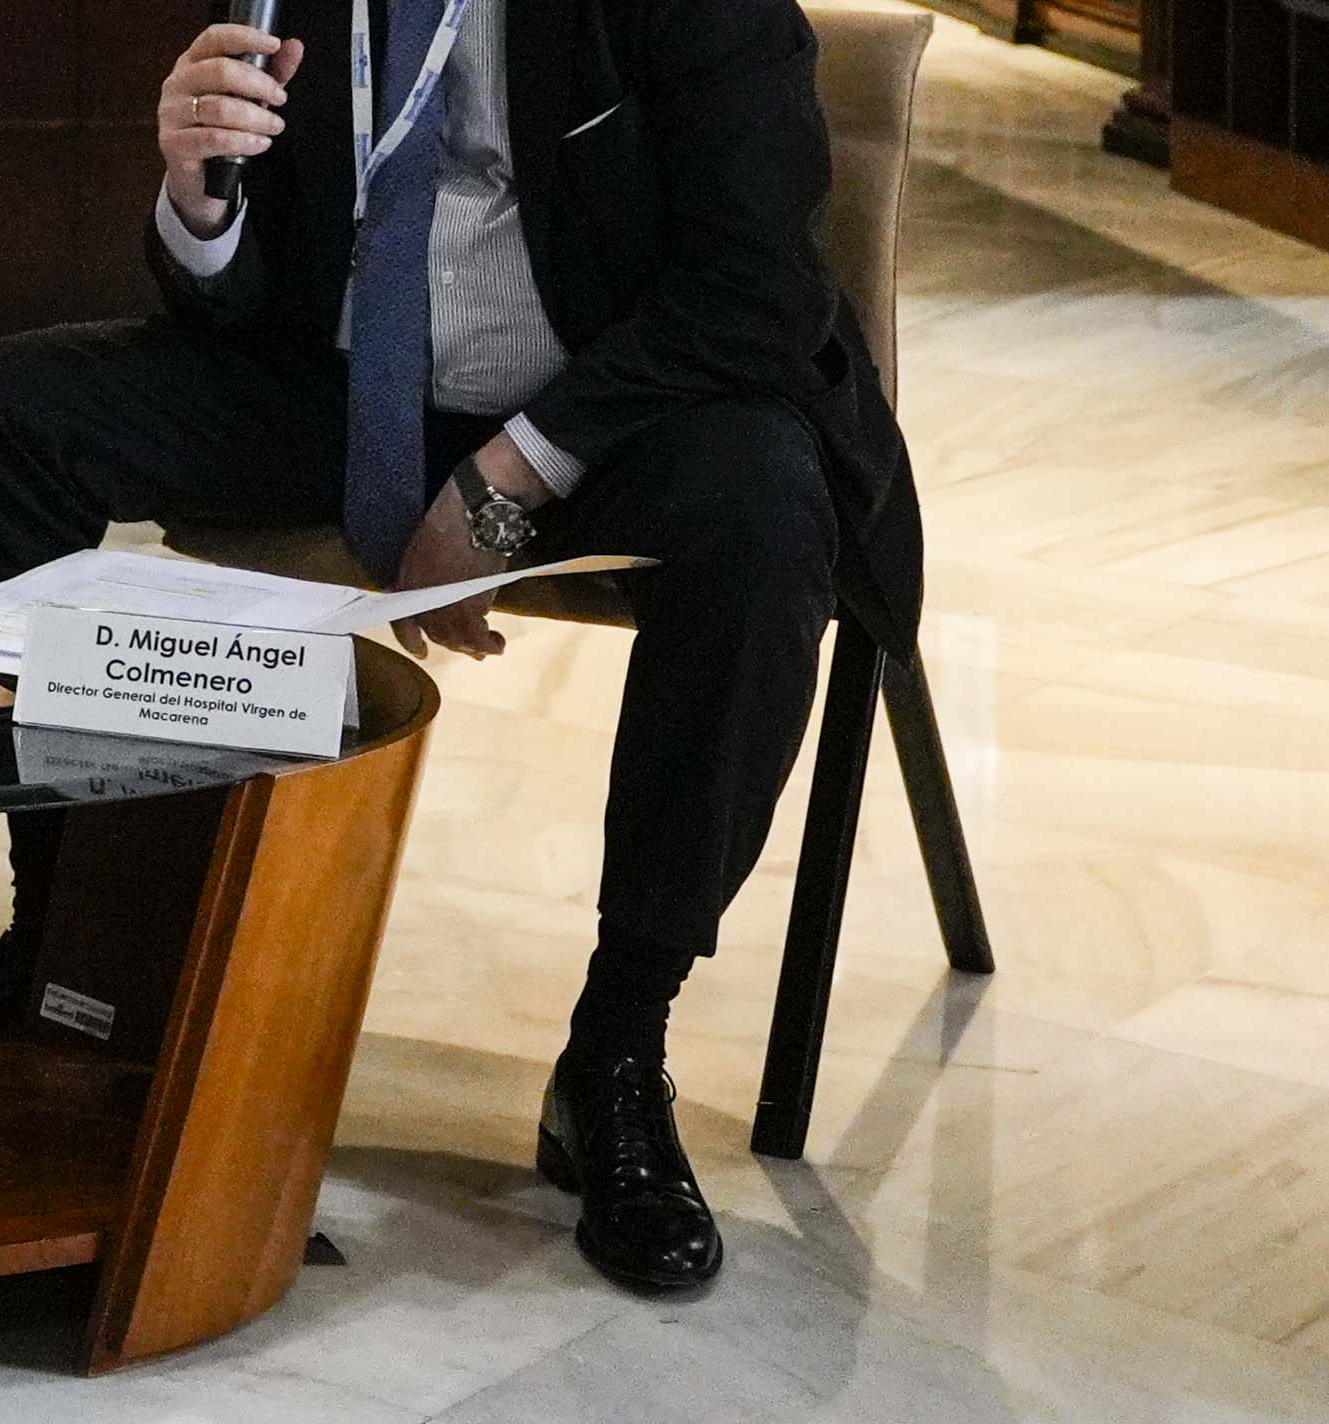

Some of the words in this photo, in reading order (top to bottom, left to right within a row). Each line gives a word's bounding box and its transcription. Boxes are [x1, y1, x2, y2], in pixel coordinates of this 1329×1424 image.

[95, 625, 119, 647] D.
[129, 629, 218, 658] Miguel
[225, 633, 305, 669] Ángel
[105, 659, 253, 694] Colmenero
[47, 681, 98, 697] Director
[102, 687, 156, 704] General
[159, 693, 181, 707] del
[184, 697, 238, 713] Hospital
[242, 703, 286, 720] Virgen
[288, 707, 308, 722] de
[138, 708, 209, 726] Macarena
